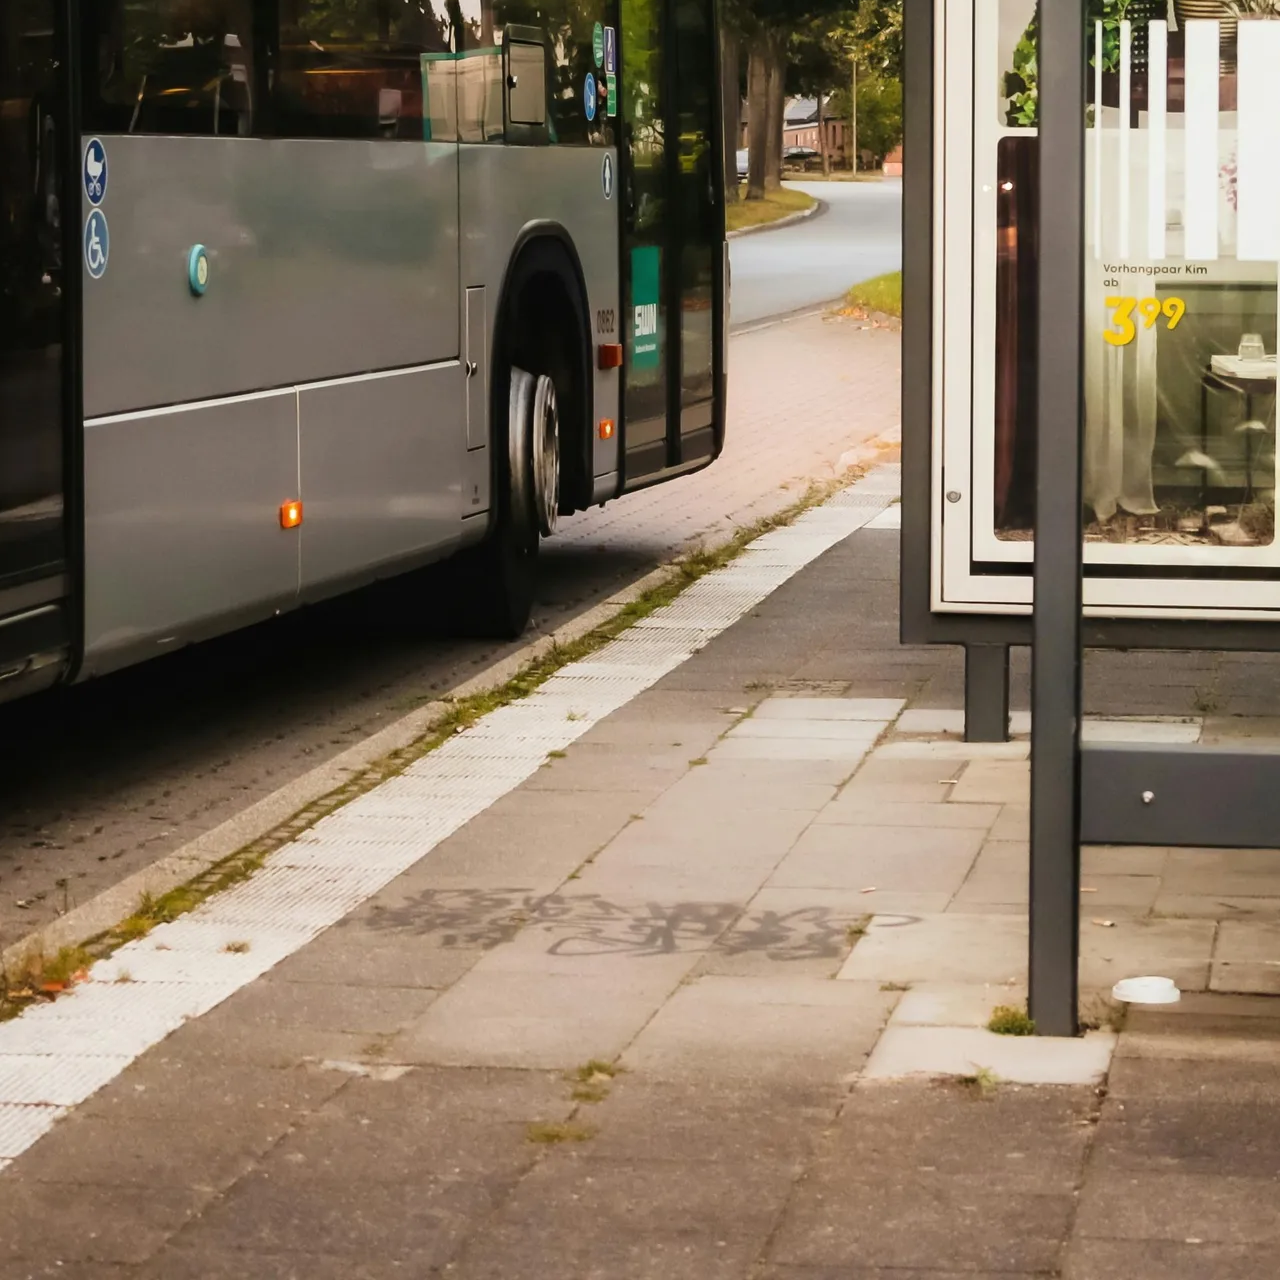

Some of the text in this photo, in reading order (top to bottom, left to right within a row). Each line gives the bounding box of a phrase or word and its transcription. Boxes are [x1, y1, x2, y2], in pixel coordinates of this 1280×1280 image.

[1103, 263, 1208, 276] Vorhangpaar Kim
[1103, 278, 1119, 287] ab
[634, 303, 657, 337] SWN
[1101, 295, 1186, 347] 399
